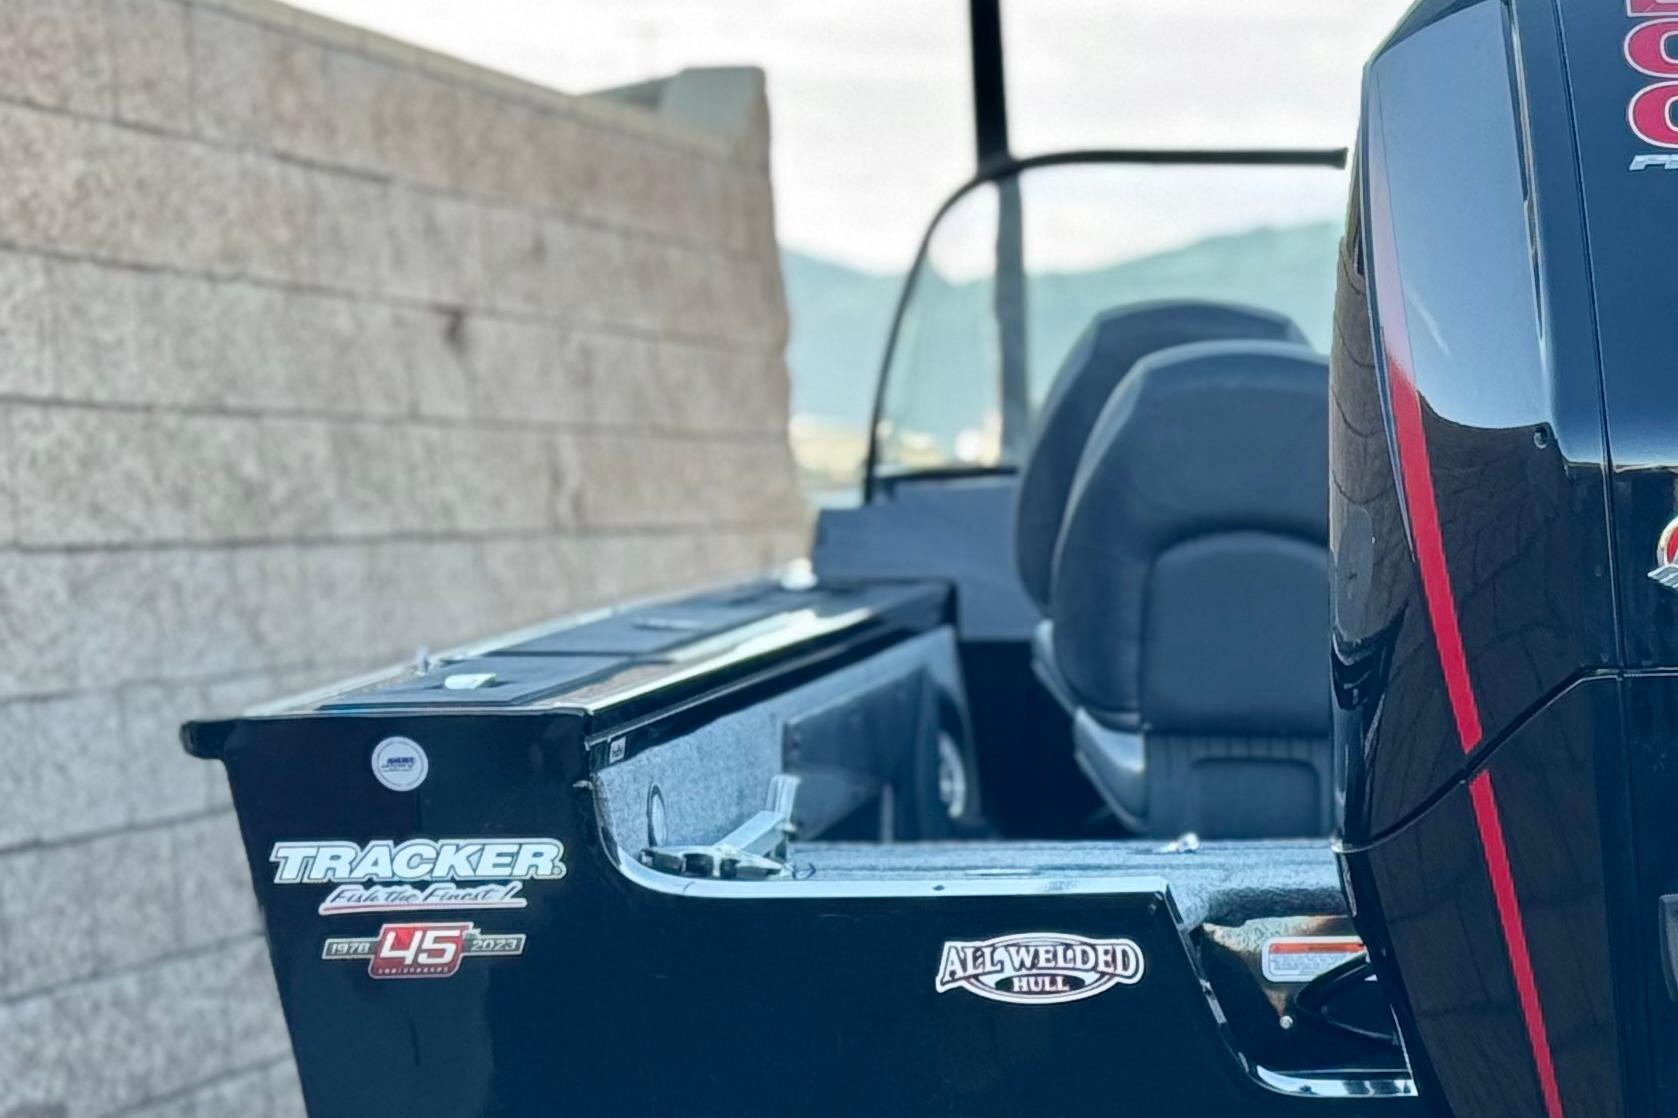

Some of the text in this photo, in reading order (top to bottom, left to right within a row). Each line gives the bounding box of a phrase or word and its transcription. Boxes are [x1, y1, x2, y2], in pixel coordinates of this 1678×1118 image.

[273, 841, 560, 881] TRACKER
[330, 888, 379, 904] Fish
[384, 888, 419, 903] the
[379, 929, 461, 965] 45
[471, 938, 517, 951] 2023
[945, 944, 1137, 982] ALL WELDED
[1013, 976, 1070, 992] HULL
